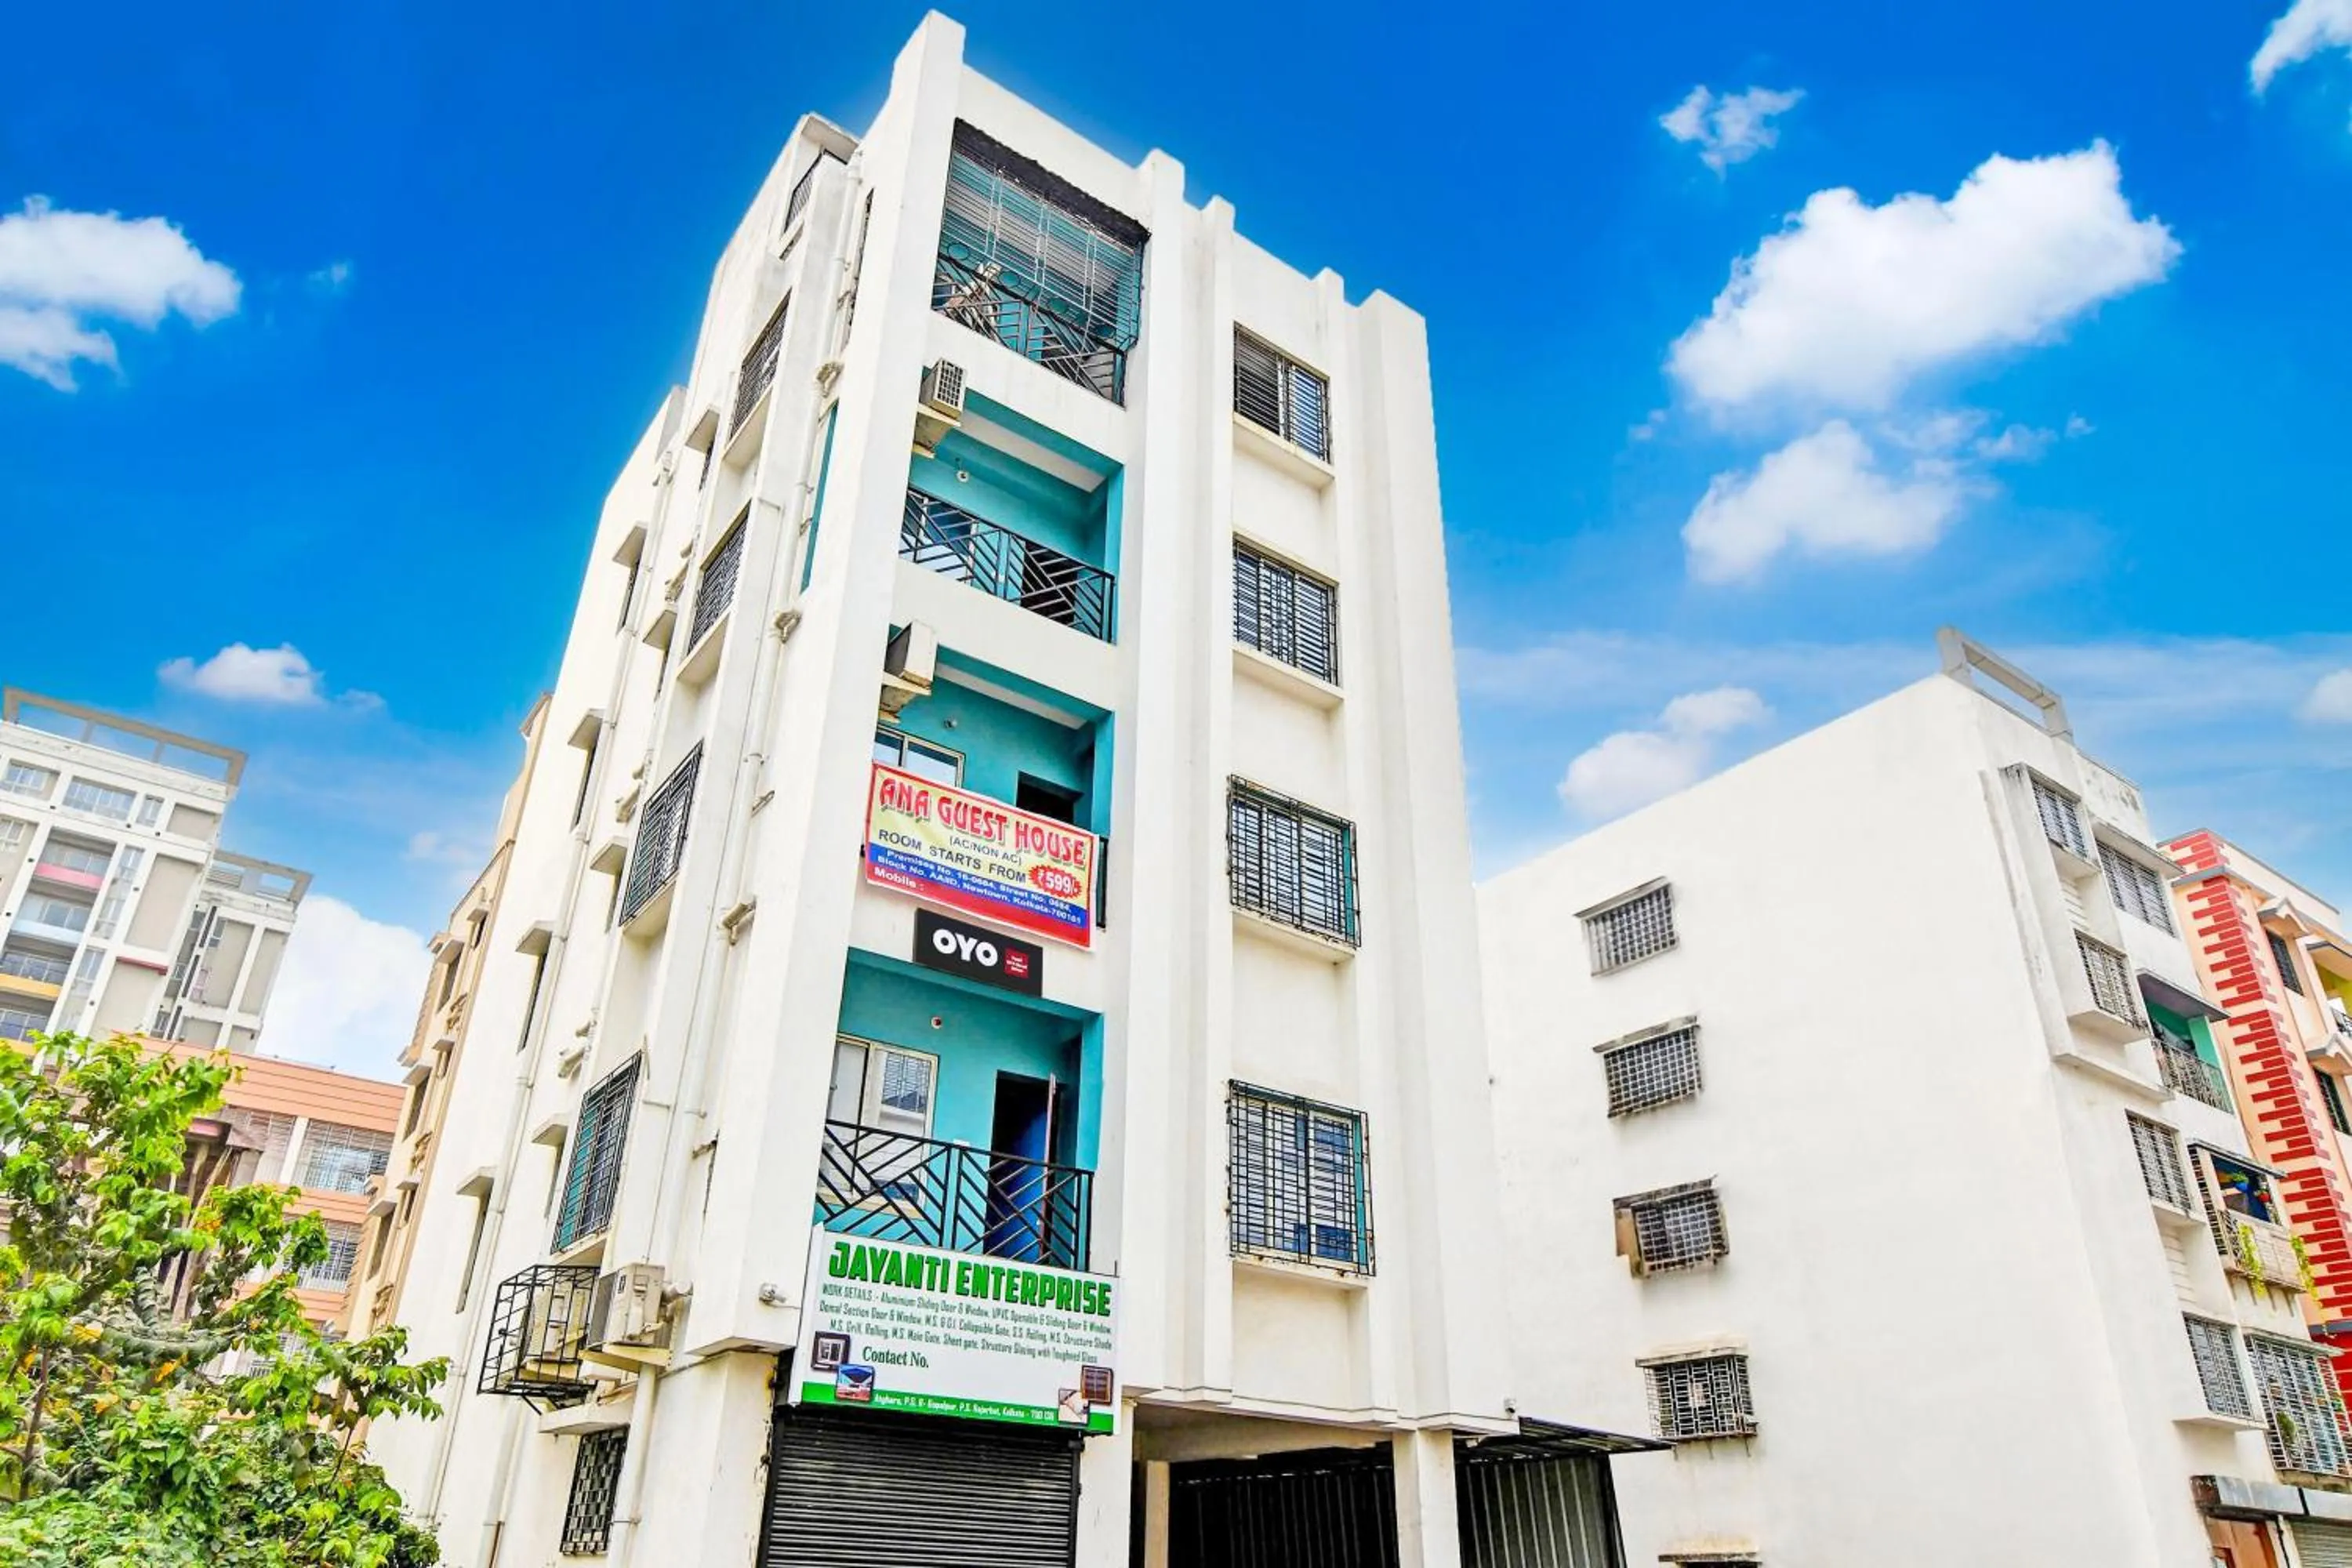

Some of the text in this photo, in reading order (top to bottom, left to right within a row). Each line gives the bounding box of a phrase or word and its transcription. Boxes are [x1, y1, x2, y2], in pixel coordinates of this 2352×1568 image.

[880, 779, 1085, 866] ANA GUEST HOUSE
[877, 855, 906, 871] Block
[879, 829, 1025, 883] ROOM STARTS FROM
[887, 850, 934, 871] Premises
[1000, 884, 1027, 898] Street
[874, 867, 916, 889] Mobile
[933, 929, 997, 967] OYO
[829, 1243, 1111, 1316] JAYANTI ENTERPRISE
[822, 1283, 843, 1297] WORK
[940, 1300, 956, 1313] Door
[1067, 1318, 1080, 1330] Door
[871, 1307, 888, 1320] Door
[862, 1346, 929, 1369] Contact No.
[1037, 1348, 1050, 1359] with
